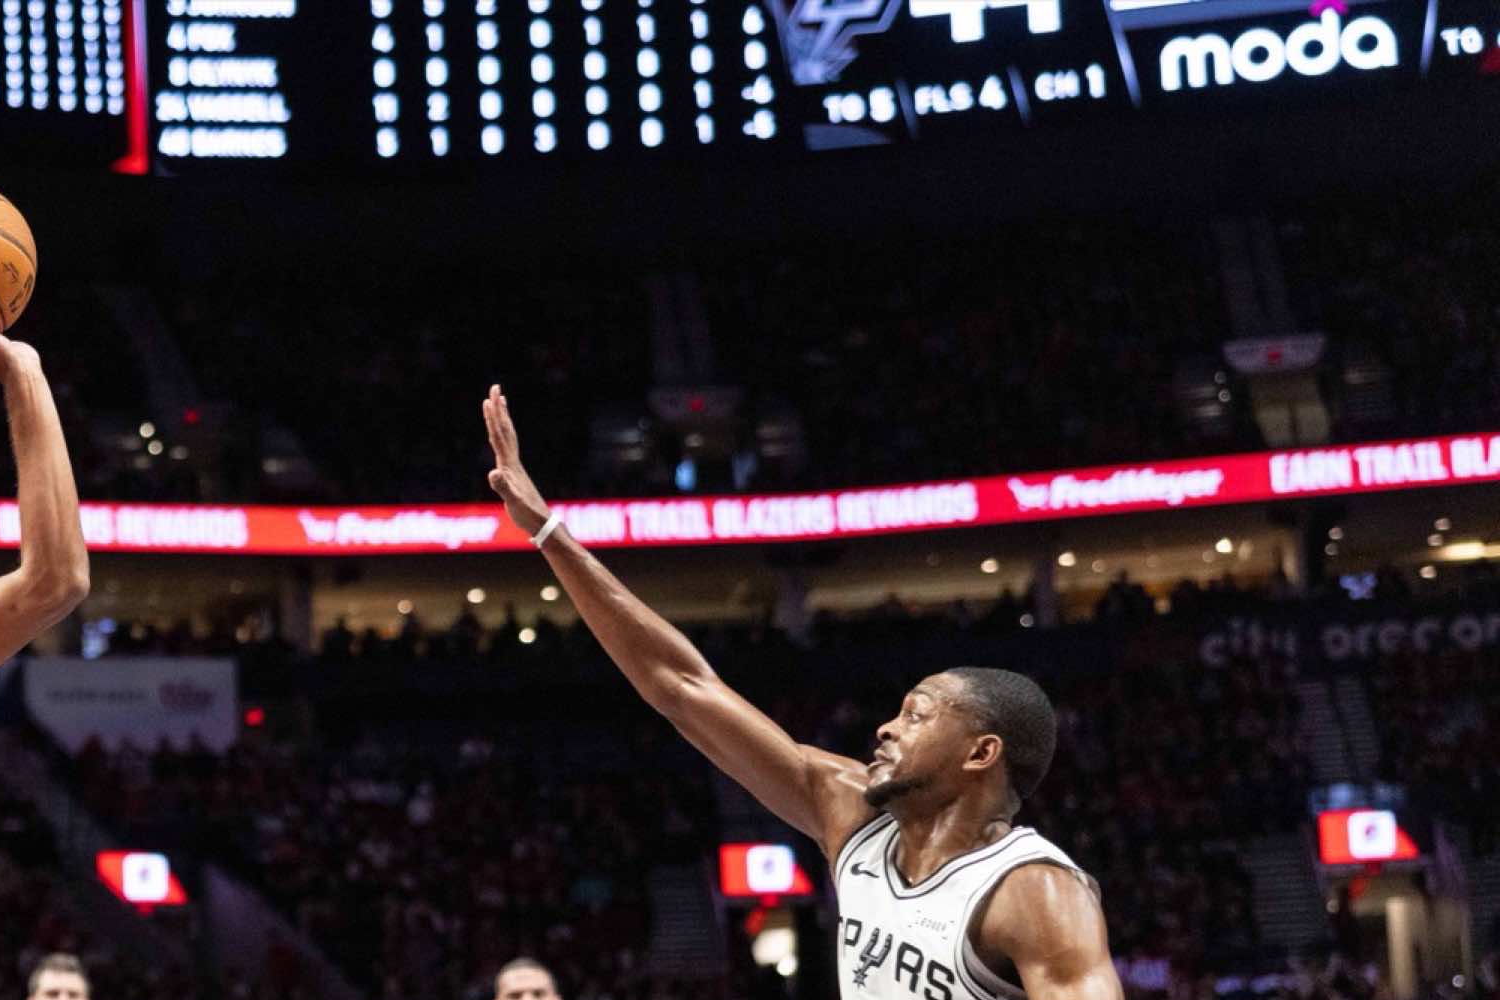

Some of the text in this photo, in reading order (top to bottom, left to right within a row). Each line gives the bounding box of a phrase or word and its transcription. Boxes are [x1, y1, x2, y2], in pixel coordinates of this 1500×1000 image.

[1159, 7, 1399, 91] moda
[1268, 449, 1353, 493] EARN
[1353, 441, 1448, 483] TRAIL
